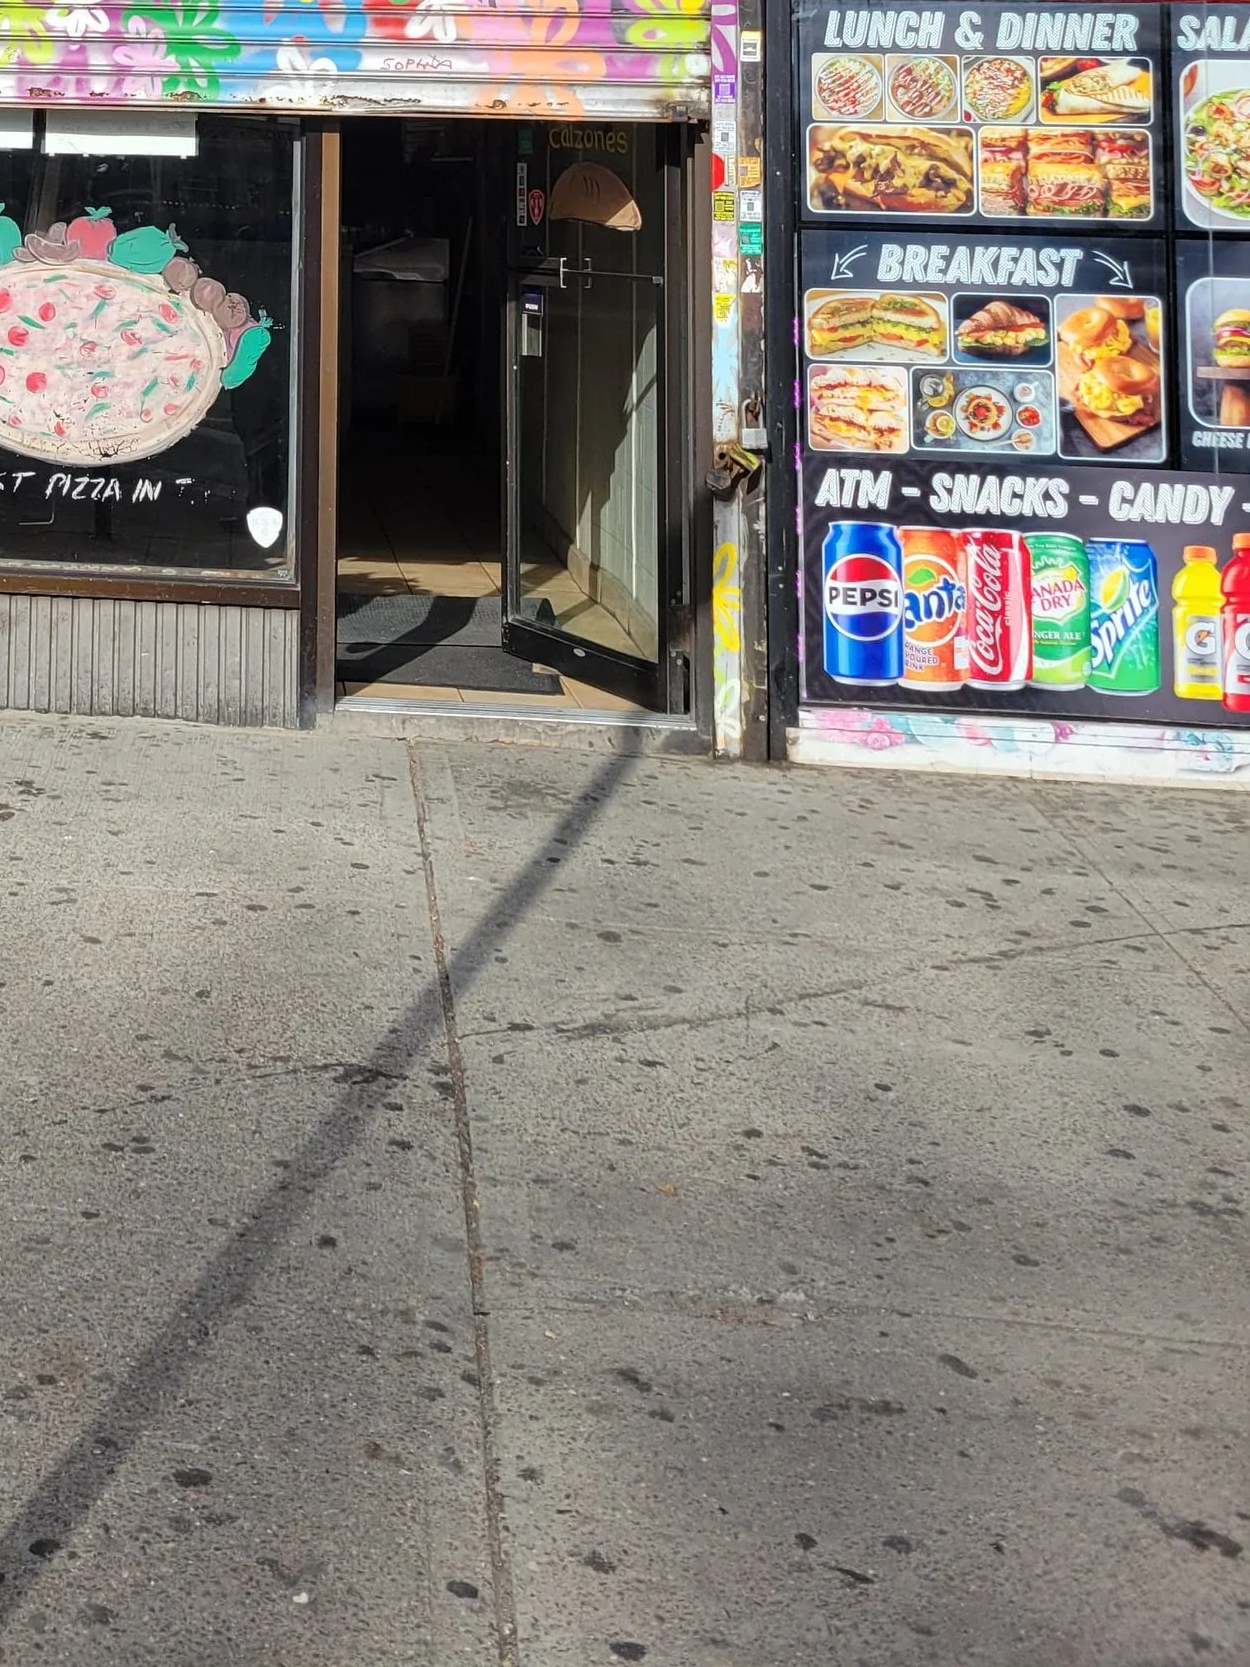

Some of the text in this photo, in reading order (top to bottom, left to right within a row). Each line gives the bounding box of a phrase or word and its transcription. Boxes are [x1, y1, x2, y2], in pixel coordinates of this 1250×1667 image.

[822, 10, 1140, 52] LUNCH & DINNER
[1176, 14, 1250, 52] SAL
[876, 244, 1084, 287] BREAKFAST
[1192, 430, 1244, 450] CHEESE
[44, 472, 121, 503] PIZZA
[814, 468, 894, 510] ATM
[929, 472, 1070, 519] SNACKS
[1108, 481, 1237, 527] CANDY
[828, 586, 899, 609] PEPSI
[1040, 594, 1072, 612] DRY
[1091, 578, 1152, 670] Sprite
